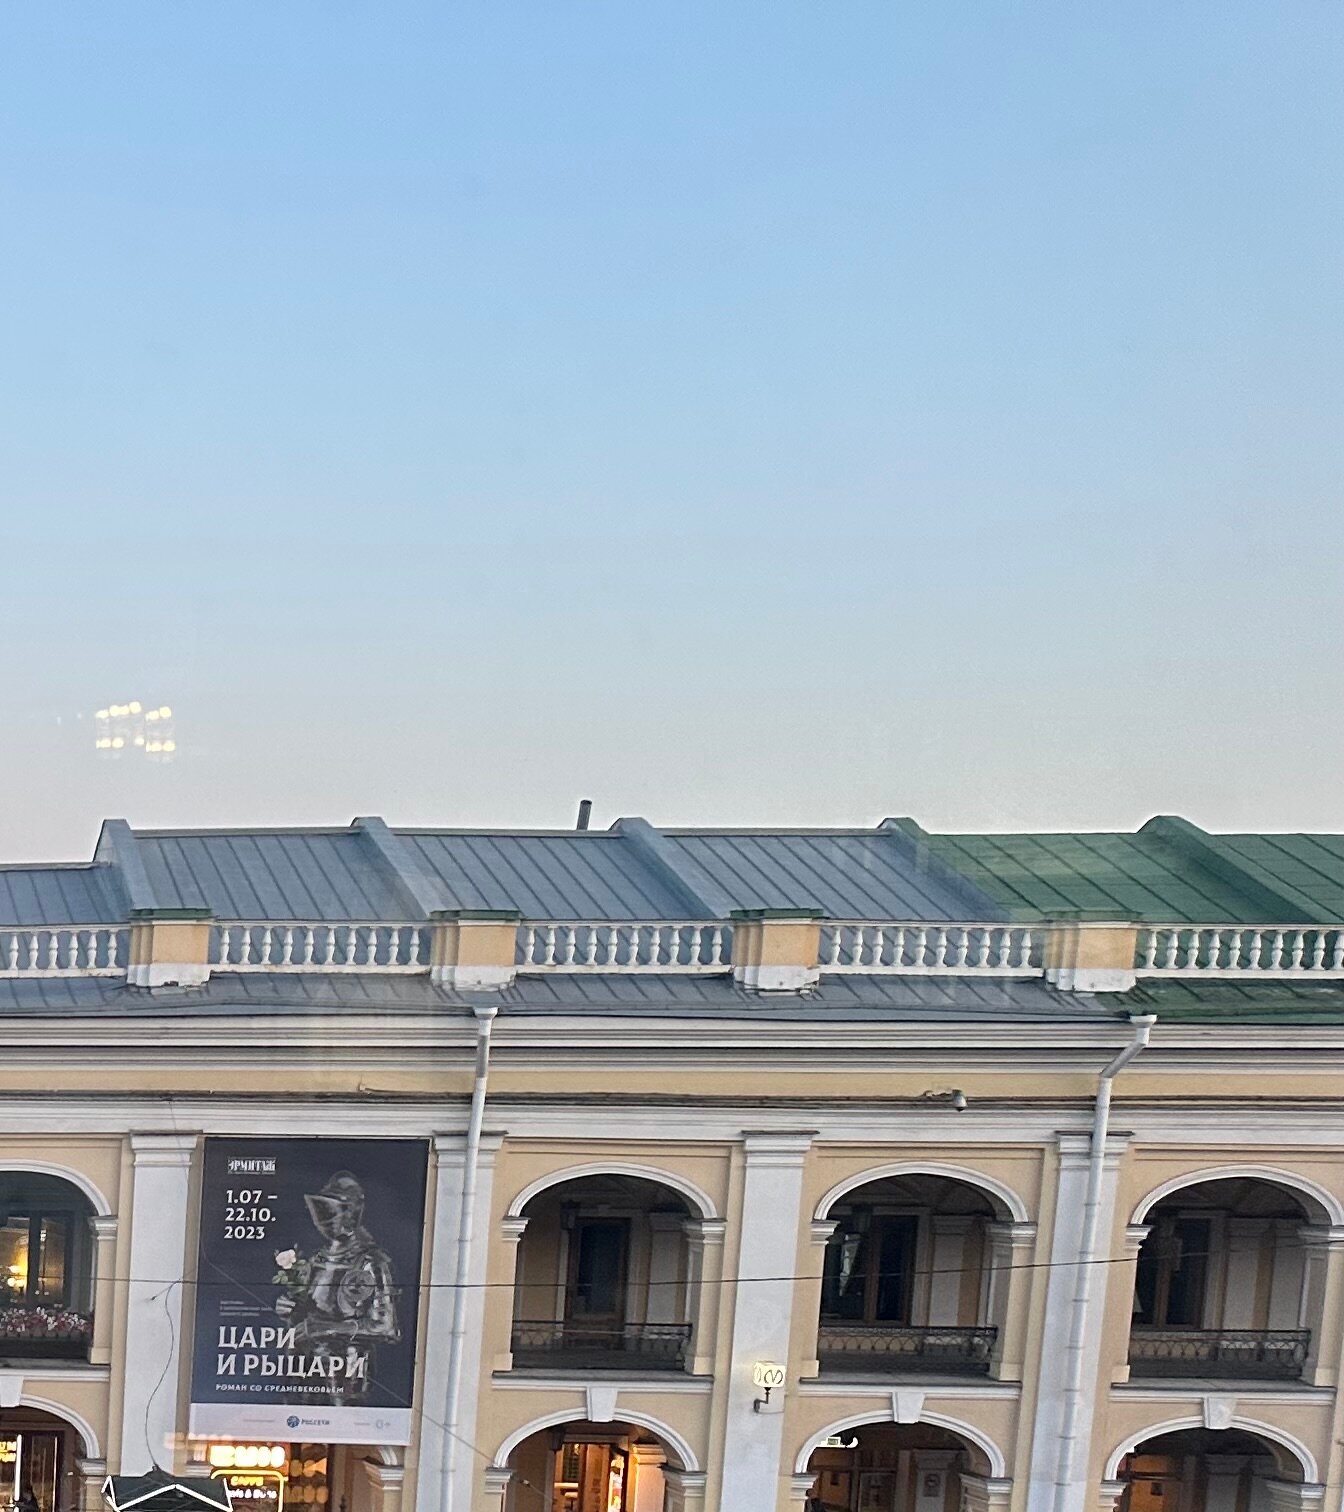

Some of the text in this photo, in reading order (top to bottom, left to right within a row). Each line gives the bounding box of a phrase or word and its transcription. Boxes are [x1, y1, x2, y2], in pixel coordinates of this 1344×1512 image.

[226, 1189, 263, 1204] 1.07
[224, 1207, 277, 1222] 22.10.
[223, 1225, 265, 1240] 2023
[217, 1325, 297, 1350] ЦАРИ
[216, 1353, 366, 1379] И РЫЦАРИ
[215, 1383, 247, 1391] РОМАН
[249, 1384, 262, 1392] СО
